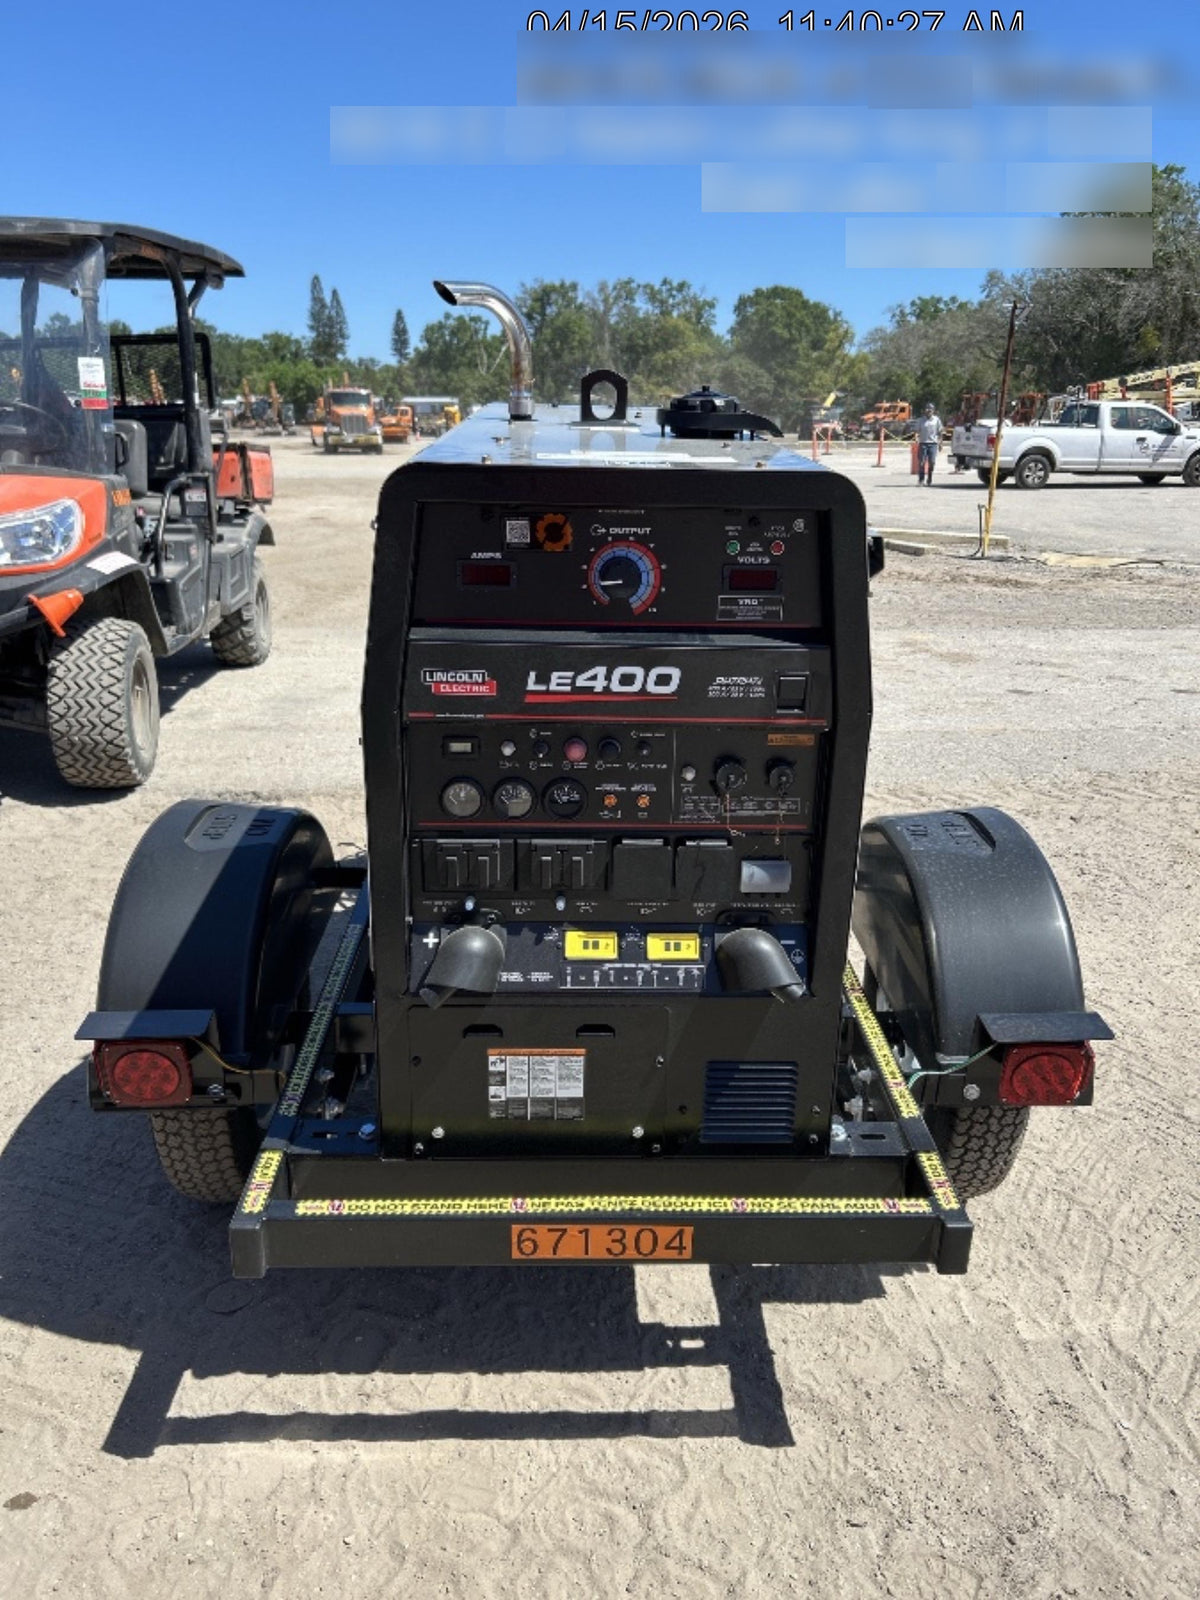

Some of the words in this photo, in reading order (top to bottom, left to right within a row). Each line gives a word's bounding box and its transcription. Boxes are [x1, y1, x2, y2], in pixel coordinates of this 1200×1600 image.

[609, 527, 651, 535] OUTPUT
[737, 556, 771, 564] VOLTS
[426, 671, 483, 683] LINCOLN
[525, 665, 682, 695] LE400
[440, 683, 490, 692] ELECTRIC
[348, 1203, 371, 1211] DO
[411, 1202, 462, 1210] STAND
[466, 1202, 509, 1210] HERE
[750, 1201, 774, 1209] NO
[776, 1201, 798, 1209] SE
[516, 1227, 688, 1257] 671304
